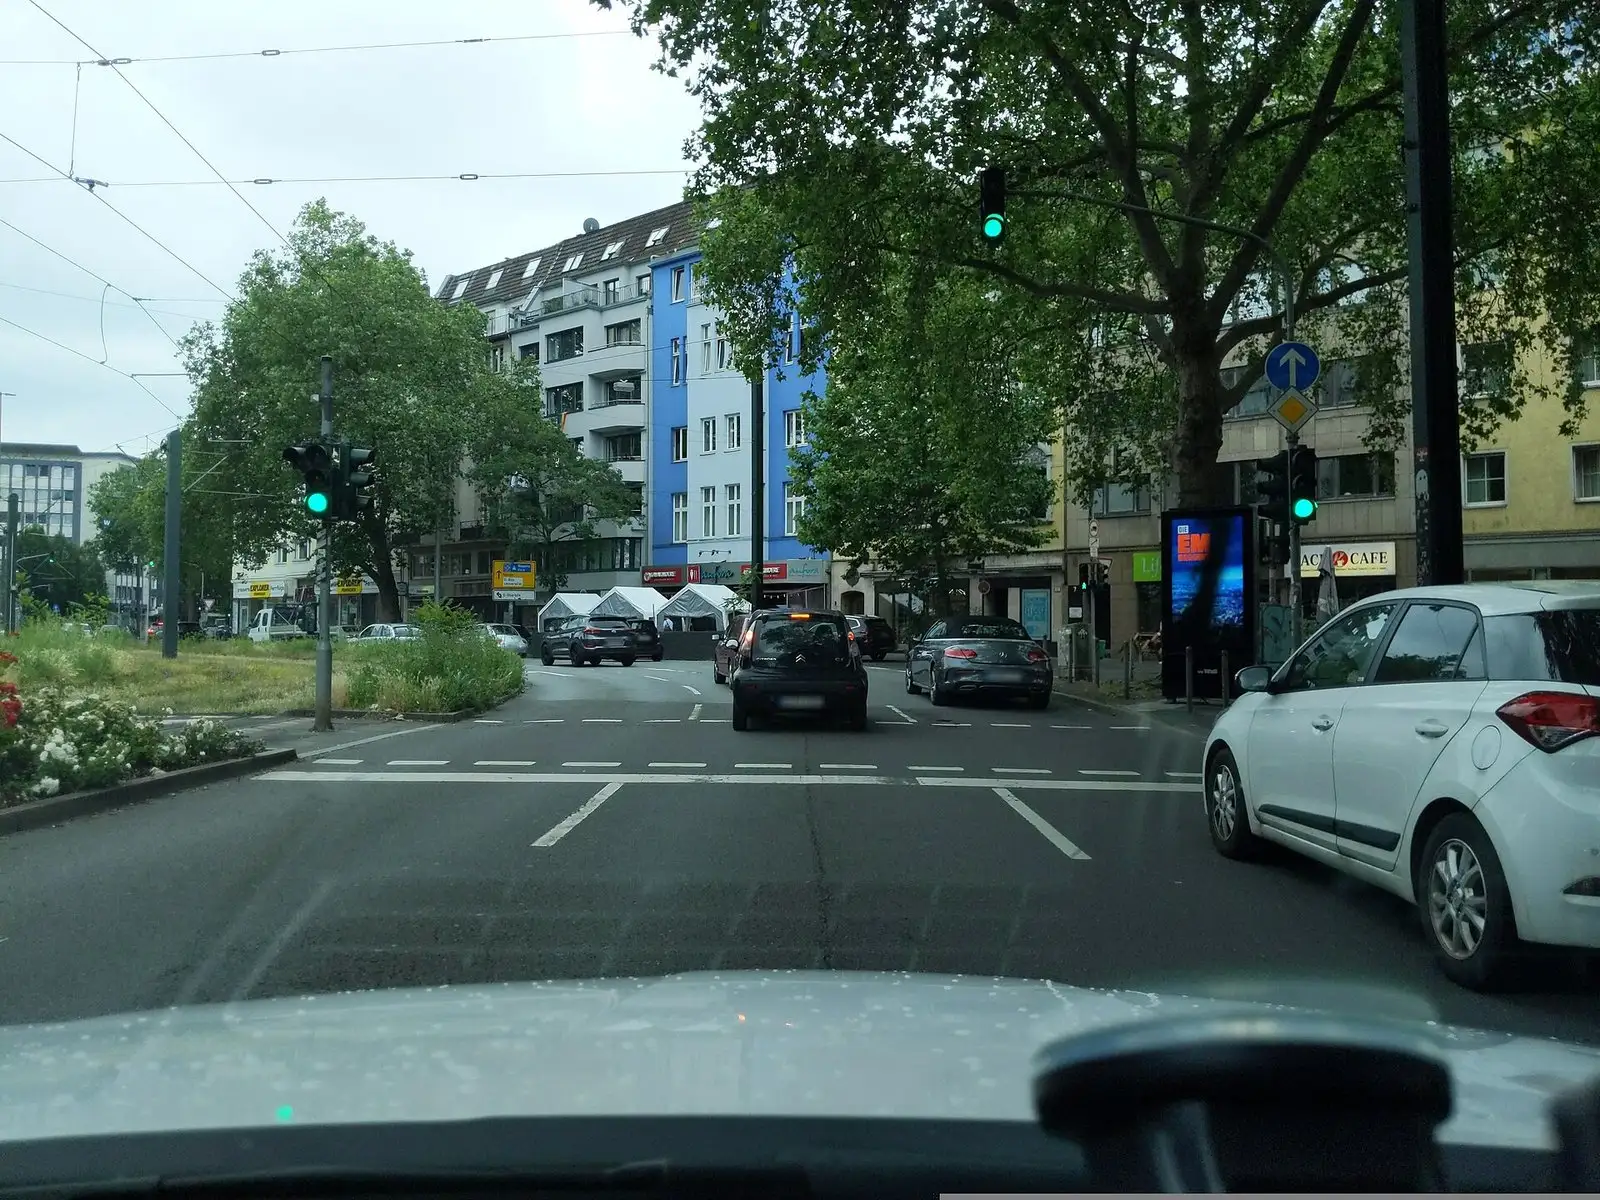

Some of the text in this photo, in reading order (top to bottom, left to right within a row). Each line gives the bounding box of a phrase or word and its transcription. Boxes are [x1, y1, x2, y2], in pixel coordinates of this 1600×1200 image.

[1178, 534, 1210, 554] EM
[1301, 551, 1388, 566] AC CAFE
